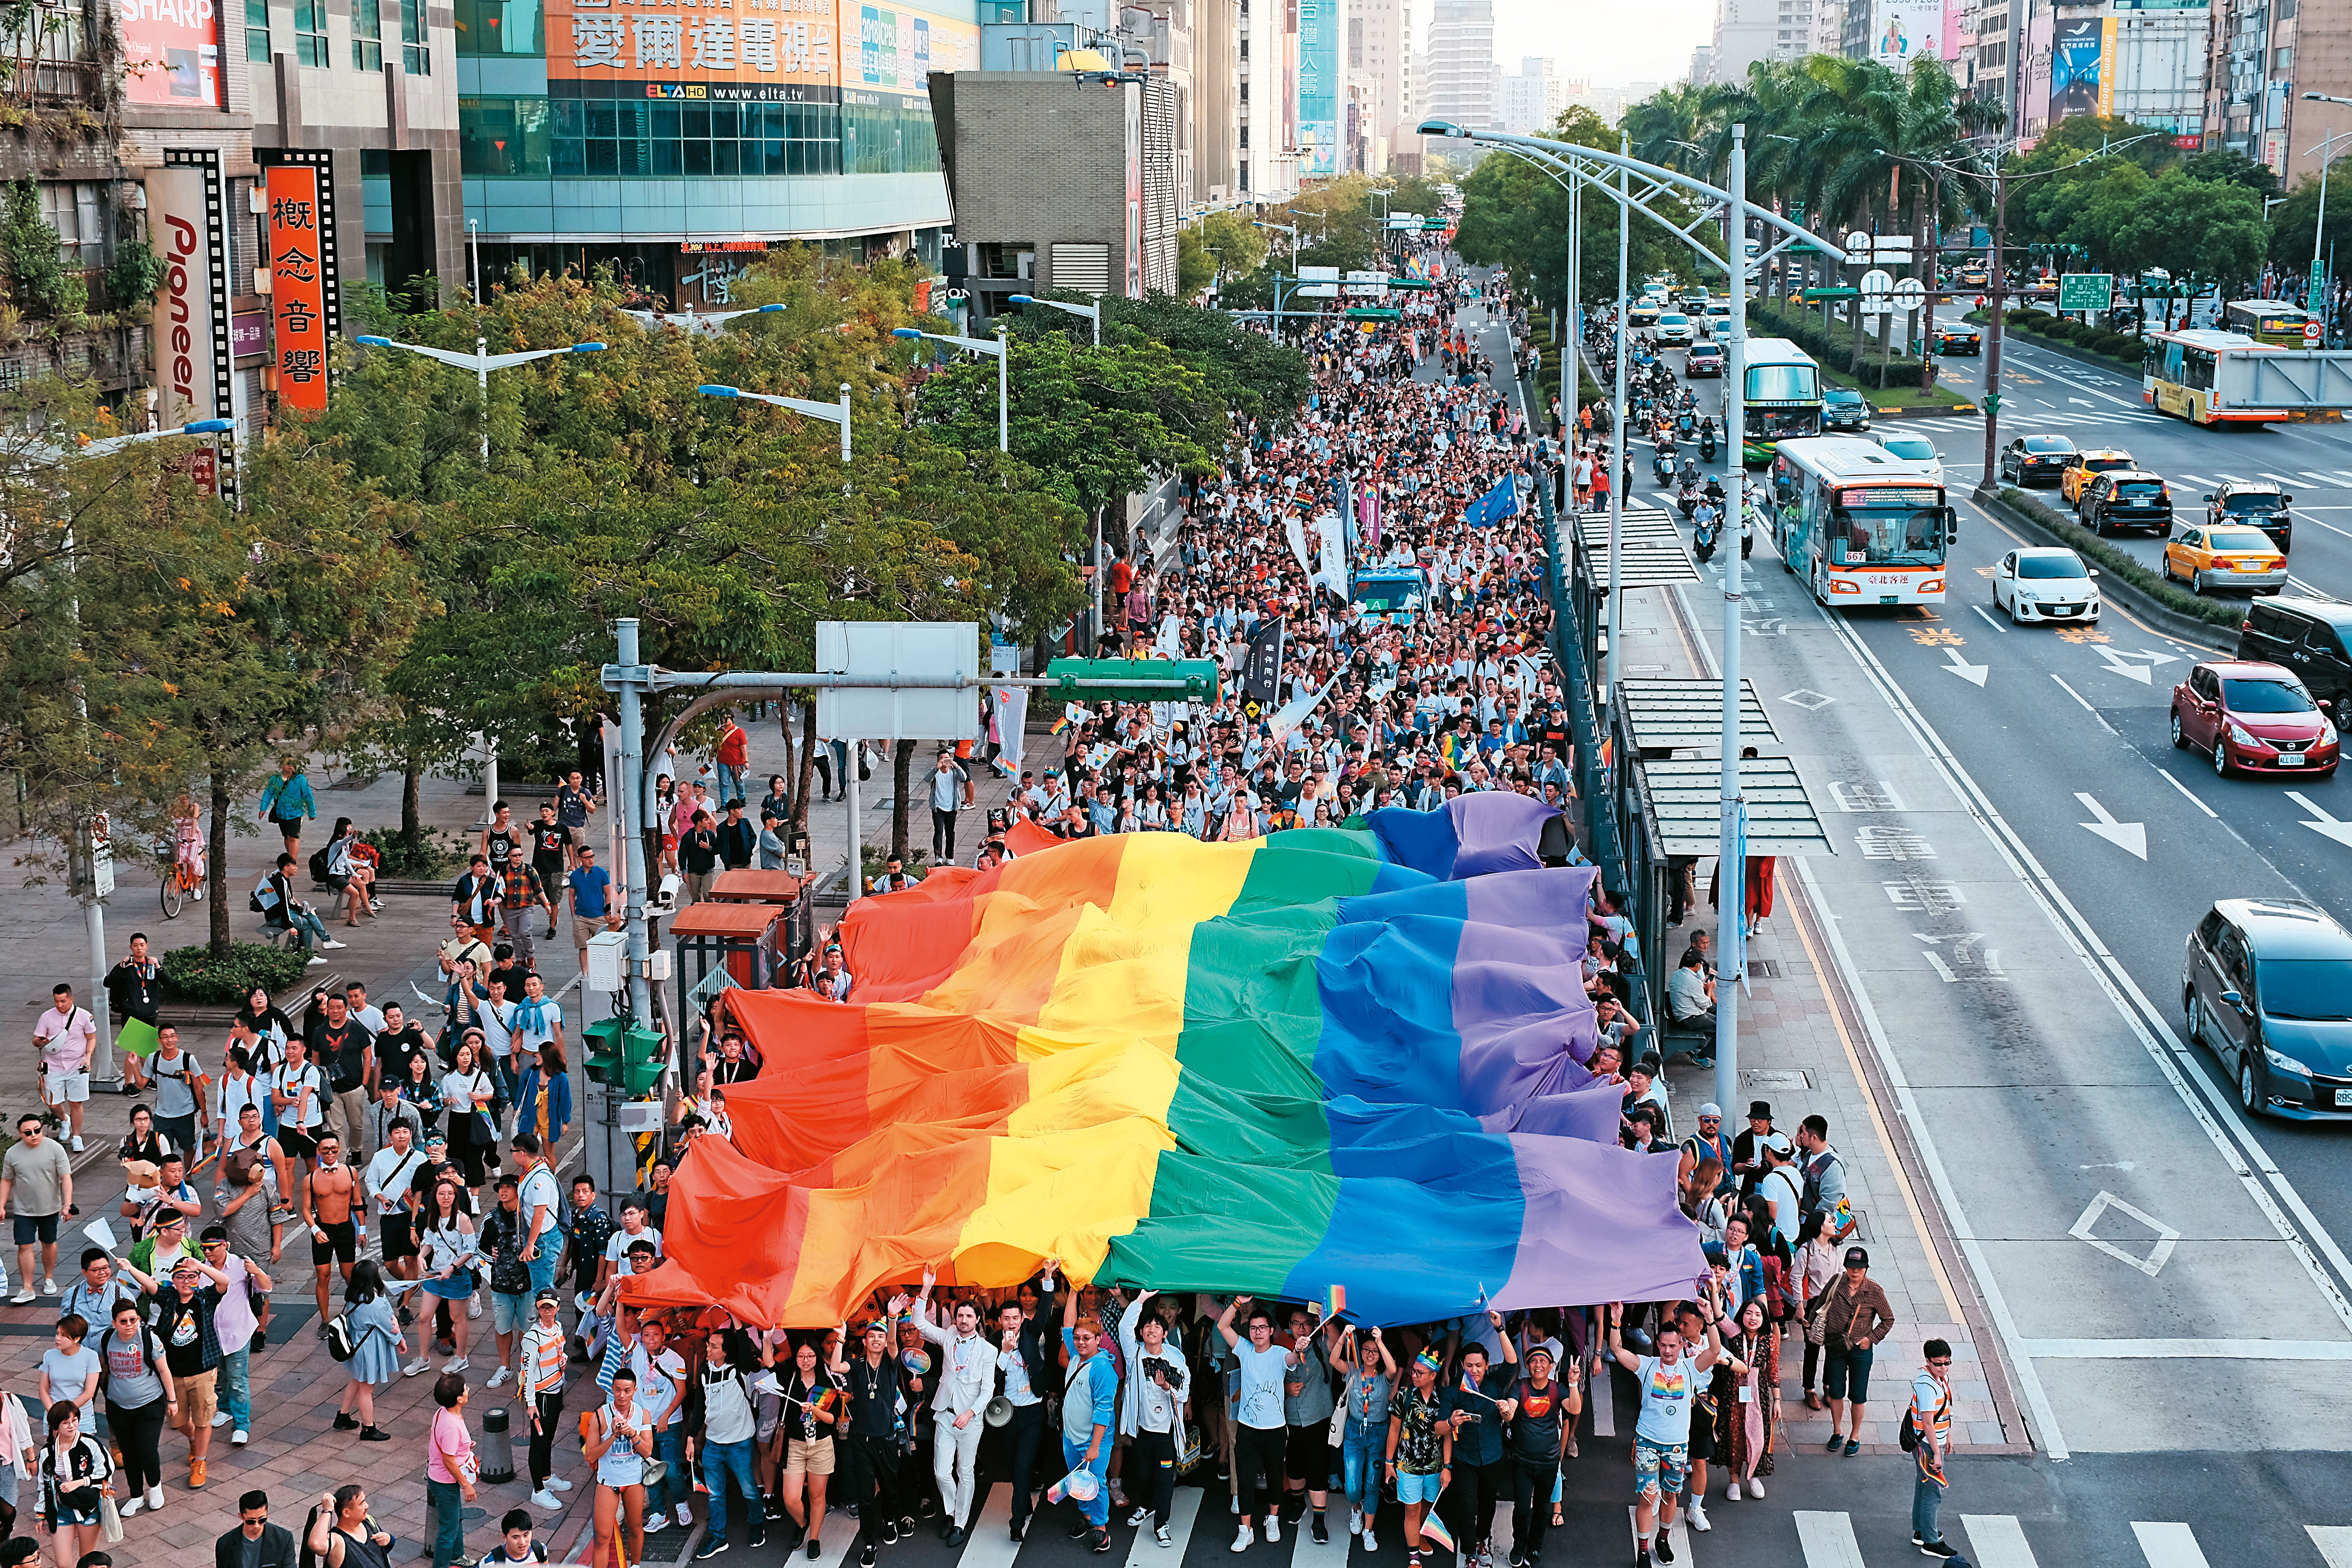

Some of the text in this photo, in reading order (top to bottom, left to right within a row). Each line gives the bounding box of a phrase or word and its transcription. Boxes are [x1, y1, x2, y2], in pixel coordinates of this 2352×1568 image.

[121, 0, 213, 29] SHARP
[126, 41, 133, 51] Be
[572, 12, 831, 74] 愛爾達電視台
[2105, 35, 2113, 77] Welcome
[646, 84, 803, 101] ELTA HD www.elta.tv
[272, 197, 321, 383] 概念音響
[165, 213, 197, 404] Pioneer
[231, 327, 261, 343] 球第一品牌
[2307, 326, 2318, 334] 40
[1846, 552, 1864, 561] 667
[1868, 575, 1909, 584] 臺北客運
[1371, 601, 1381, 611] A
